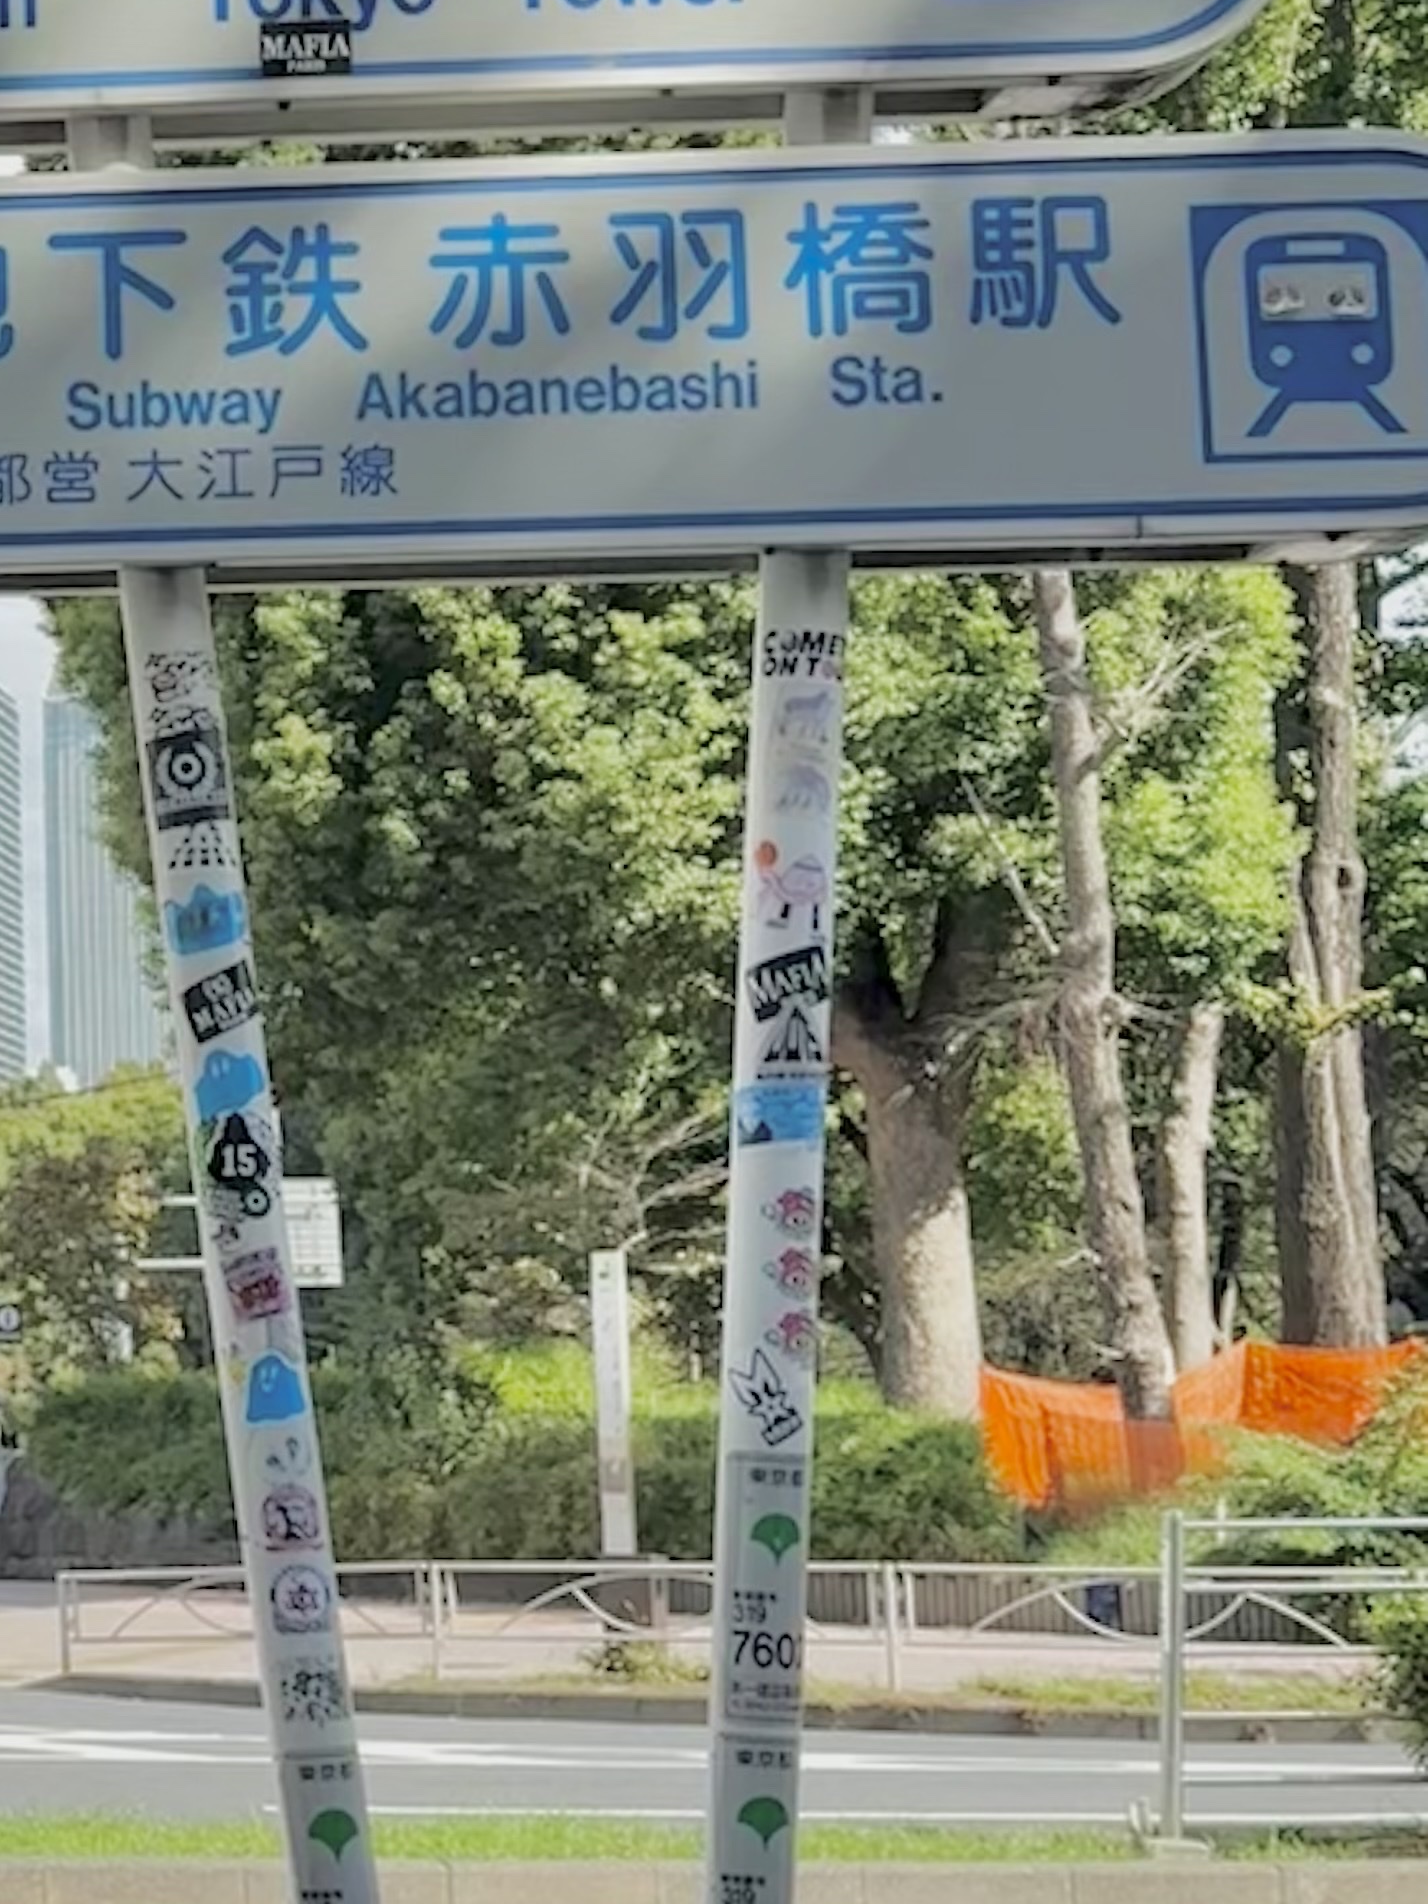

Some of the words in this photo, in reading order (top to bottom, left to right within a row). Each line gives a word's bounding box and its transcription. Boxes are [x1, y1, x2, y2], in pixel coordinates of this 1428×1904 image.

[261, 32, 350, 60] MAFIA
[67, 380, 283, 434] Subway
[356, 359, 760, 423] Akabanebashi
[831, 354, 944, 407] Sta.
[220, 1143, 258, 1178] 15
[732, 1630, 802, 1670] 760
